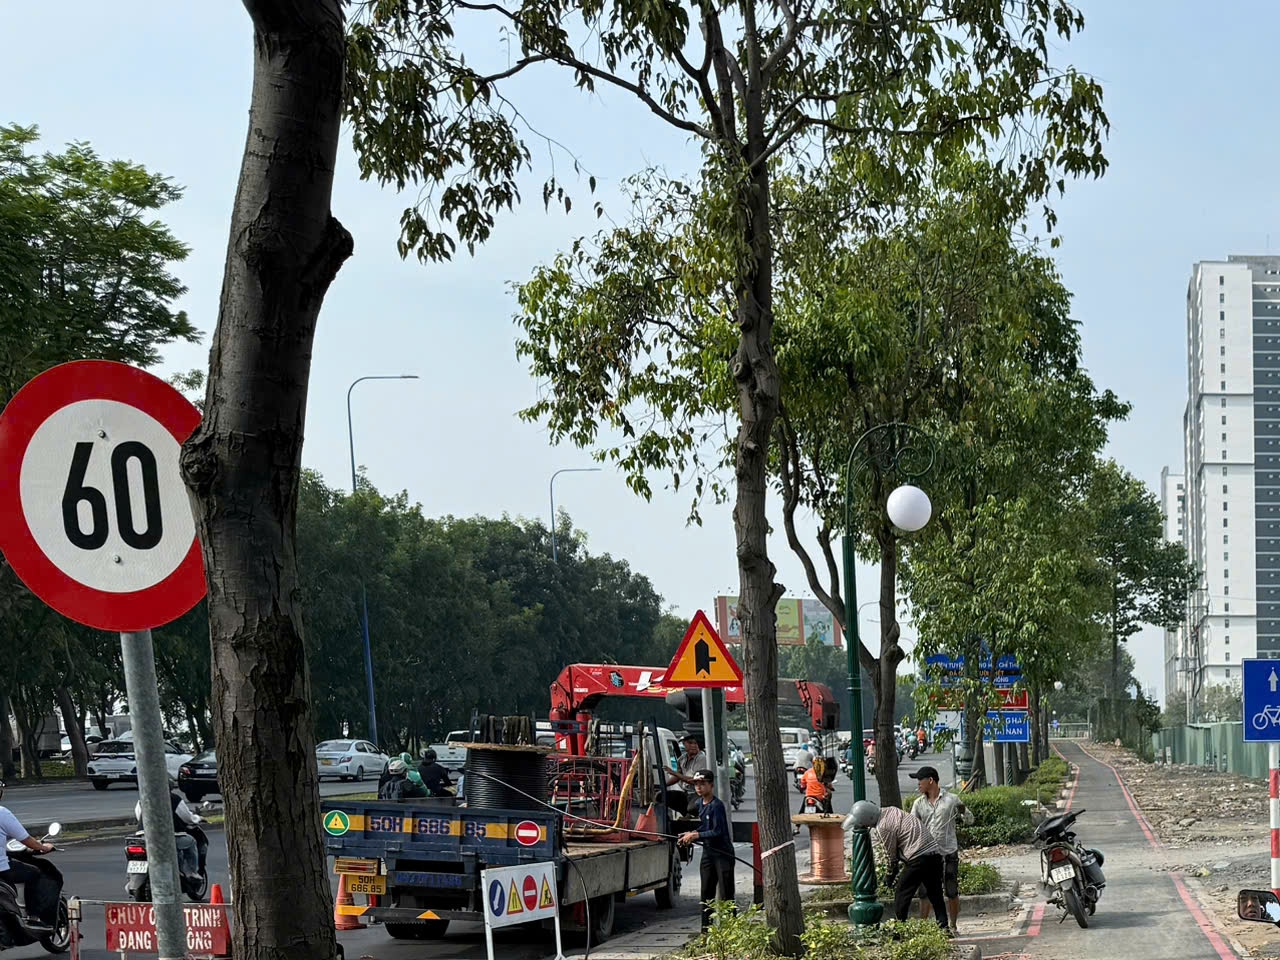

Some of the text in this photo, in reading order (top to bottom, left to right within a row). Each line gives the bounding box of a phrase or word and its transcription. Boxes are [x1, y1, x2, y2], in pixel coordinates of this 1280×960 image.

[62, 441, 163, 550] 60
[370, 815, 403, 832] 50H
[351, 884, 382, 893] 686.85
[358, 876, 375, 884] 50H
[119, 930, 151, 950] ĐANG
[186, 927, 213, 950] ÔNG
